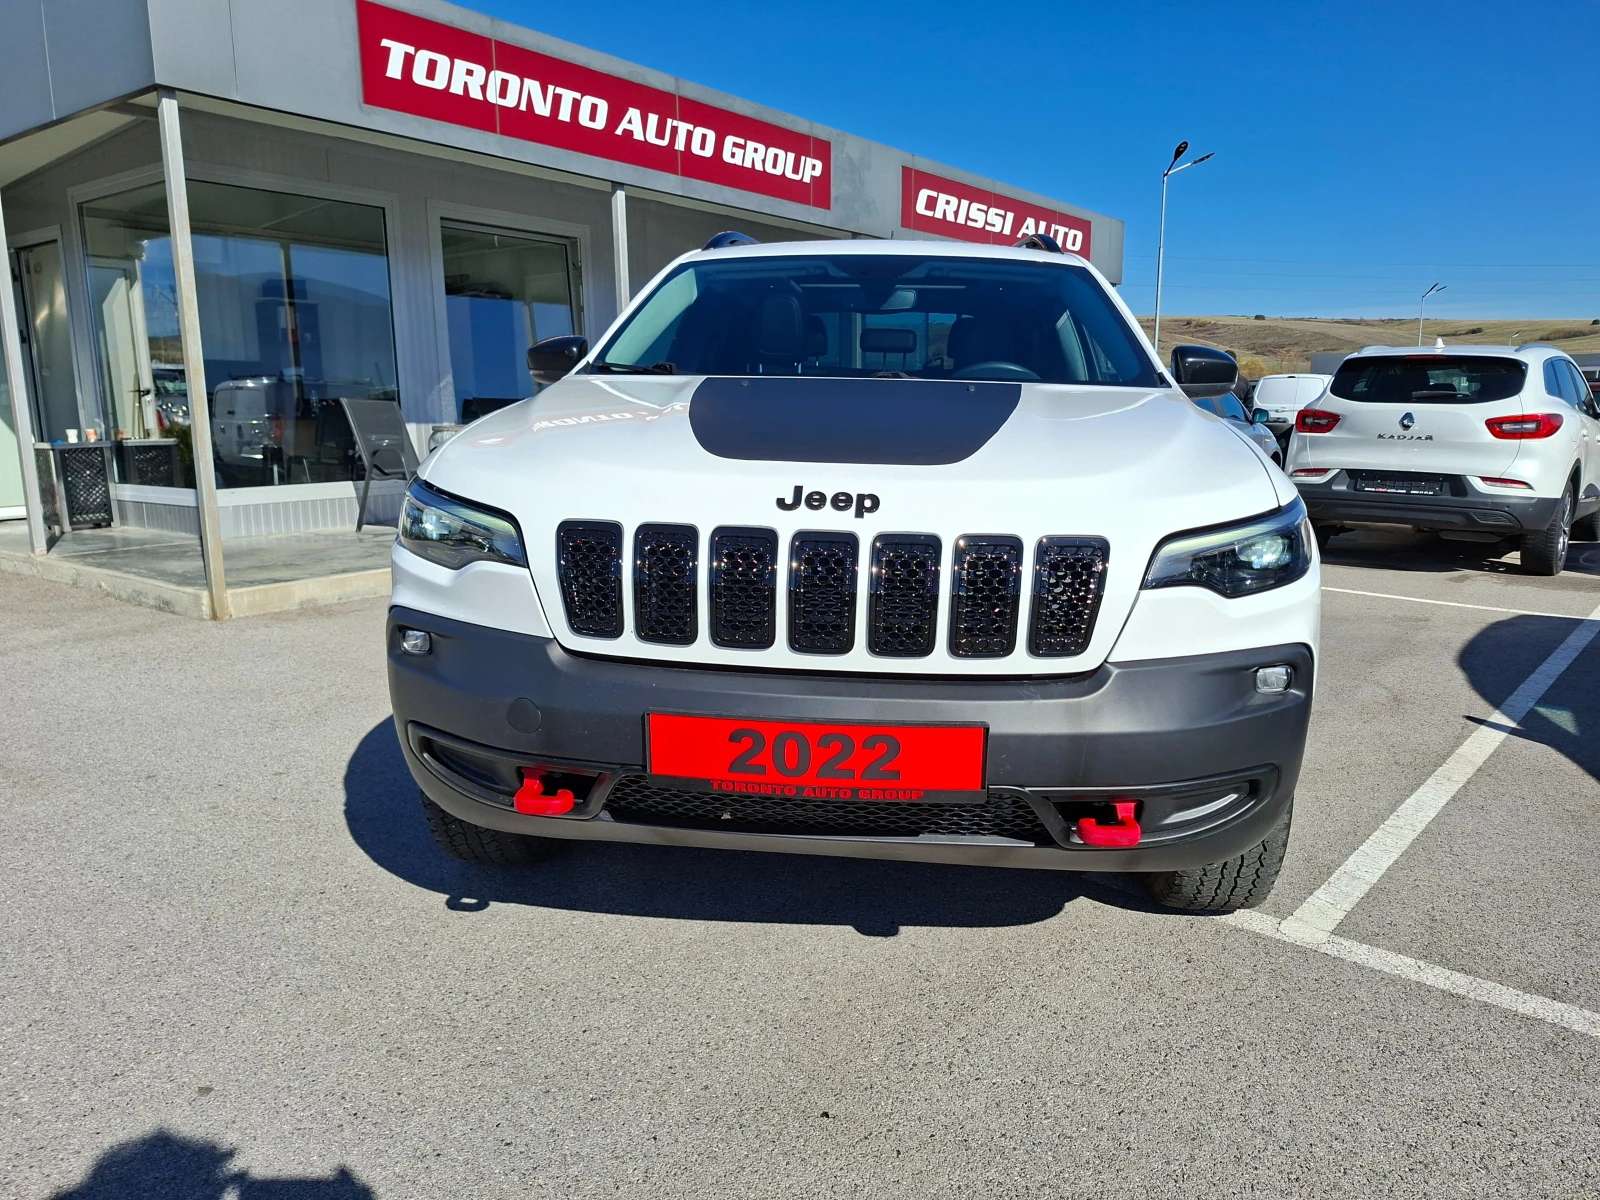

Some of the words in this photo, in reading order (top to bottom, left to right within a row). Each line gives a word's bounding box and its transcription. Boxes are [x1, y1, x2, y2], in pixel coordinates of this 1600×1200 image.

[380, 38, 609, 131] TORONTO
[614, 106, 716, 158] AUTO
[722, 135, 823, 184] GROUP
[915, 188, 1015, 236] CRISSI
[1376, 433, 1434, 441] KADJAR
[776, 485, 881, 519] Jeep
[727, 728, 902, 781] 2022
[710, 780, 797, 797] TORONTO
[803, 786, 852, 799] AUTO
[858, 789, 924, 801] GROUP
